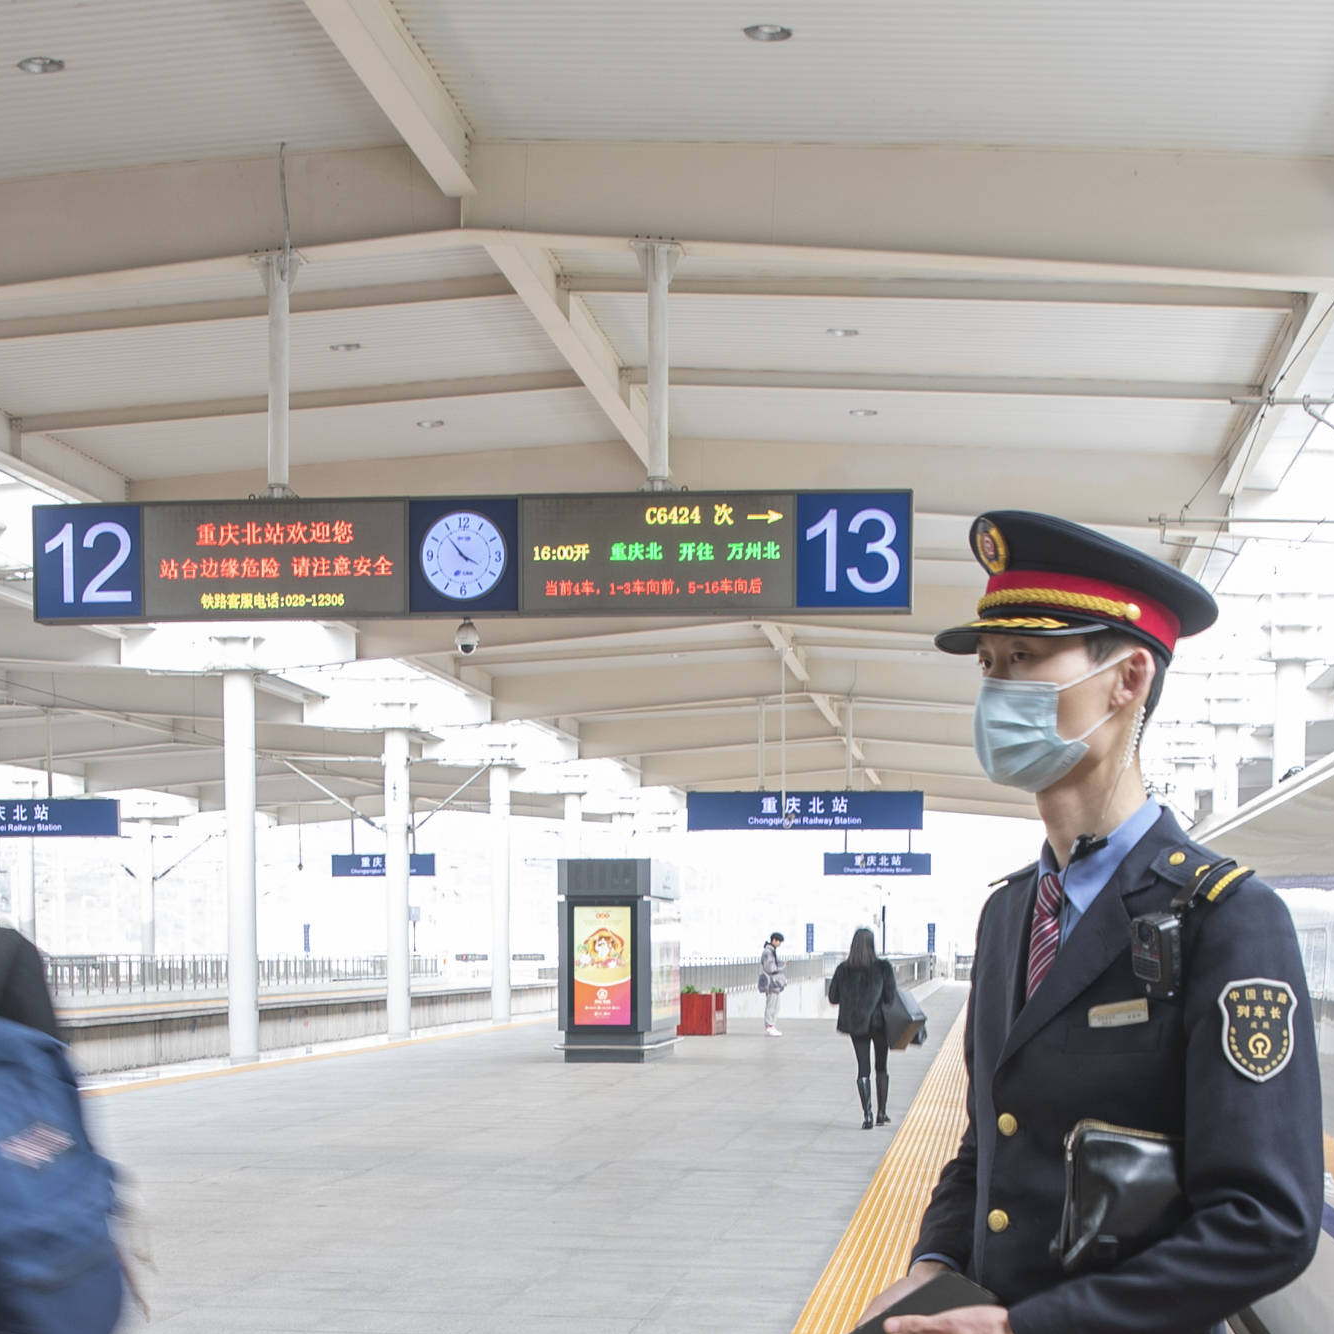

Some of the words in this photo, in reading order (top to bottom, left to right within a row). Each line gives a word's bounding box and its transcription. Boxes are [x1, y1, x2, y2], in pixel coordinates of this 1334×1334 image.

[458, 516, 470, 529] 12
[645, 506, 702, 525] C6424
[713, 504, 734, 526] 次
[196, 520, 355, 546] 重庆北站欢迎您
[426, 551, 434, 562] 9
[495, 551, 502, 562] 3
[533, 543, 590, 562] 16:00开
[610, 541, 663, 562] 重庆北
[678, 541, 715, 562] 开往
[726, 541, 781, 561] 万州北
[806, 508, 901, 593] 13
[45, 521, 132, 604] 12
[159, 557, 281, 580] 站台边缘危险
[291, 554, 395, 578] 请注意安全
[459, 583, 467, 596] 6
[201, 592, 345, 610] 铁路客服电话:028-12306
[761, 797, 848, 814] 重庆北站
[8, 823, 36, 833] Railway
[37, 823, 62, 832] Station
[803, 816, 833, 826] Railway
[835, 816, 862, 824] Station
[854, 855, 902, 866] 重庆北站
[1236, 1004, 1282, 1019] 列车长
